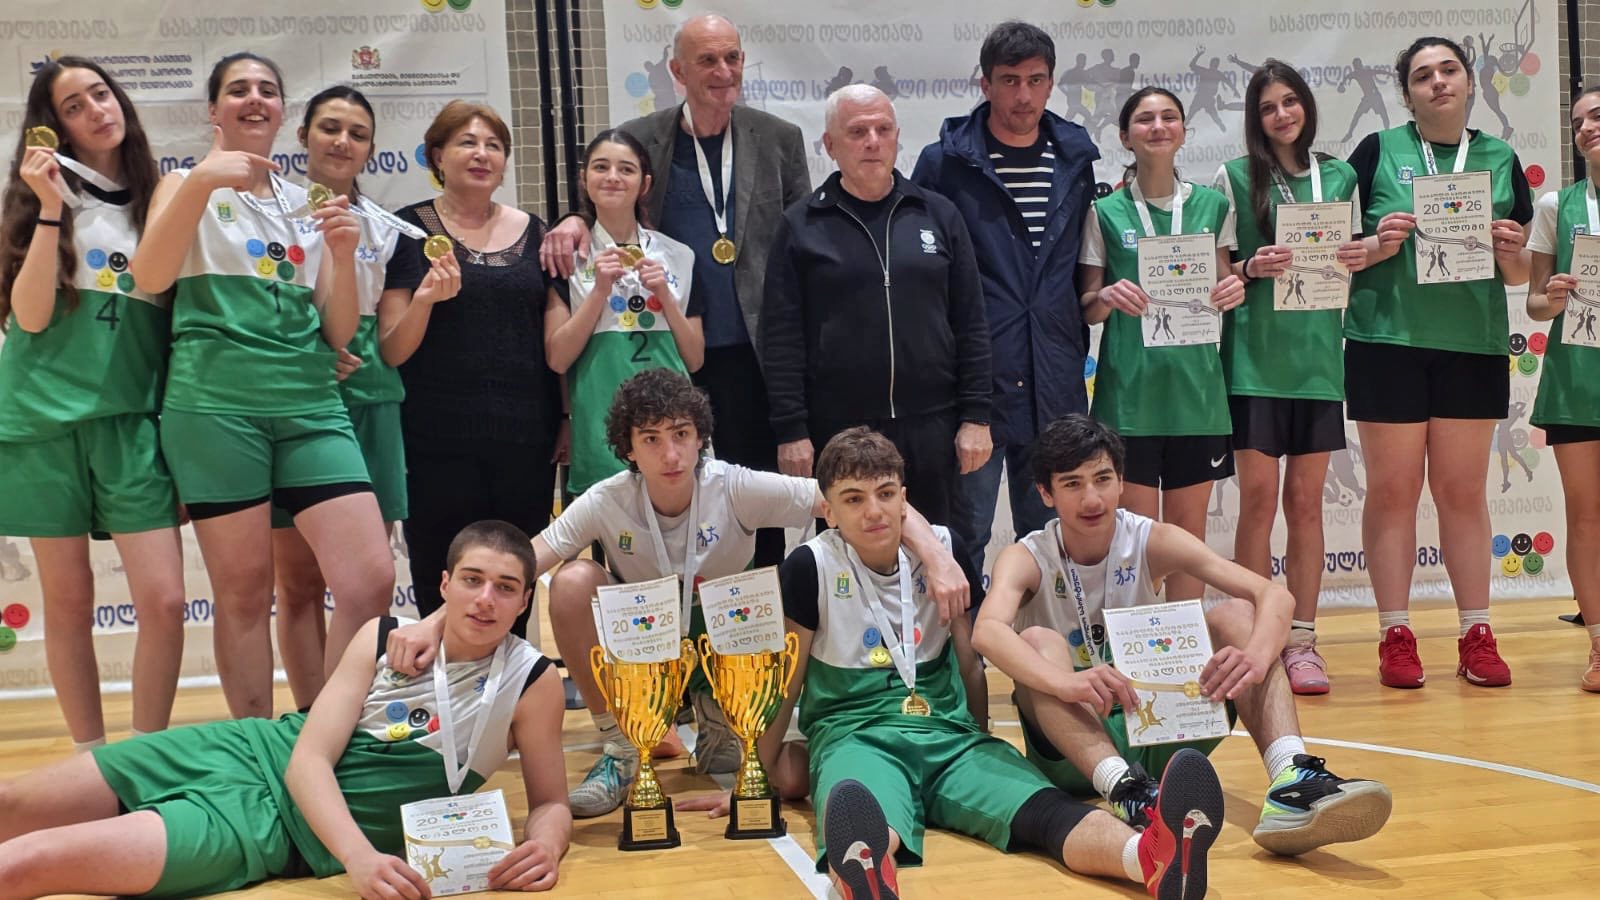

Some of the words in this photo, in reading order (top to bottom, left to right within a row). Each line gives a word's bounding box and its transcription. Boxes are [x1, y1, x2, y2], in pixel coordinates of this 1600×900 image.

[1138, 17, 1236, 38] ოლიმპიადა
[1269, 12, 1350, 33] სასკოლო
[1354, 9, 1443, 30] სპორტული
[819, 22, 923, 42] ოლიმპიადა
[1423, 203, 1440, 215] 20
[1465, 200, 1482, 211] 26
[1285, 232, 1302, 243] 20
[1326, 230, 1342, 241] 26
[1148, 265, 1165, 277] 20
[1190, 262, 1207, 274] 26
[1580, 264, 1598, 276] 20
[96, 294, 120, 331] 4
[628, 331, 651, 363] 2
[611, 619, 629, 634] 20
[658, 611, 674, 627] 26
[710, 613, 726, 629] 20
[754, 603, 773, 619] 26
[1122, 641, 1144, 656] 20
[1176, 635, 1198, 650] 26
[416, 817, 438, 827] 20
[471, 808, 494, 818] 26
